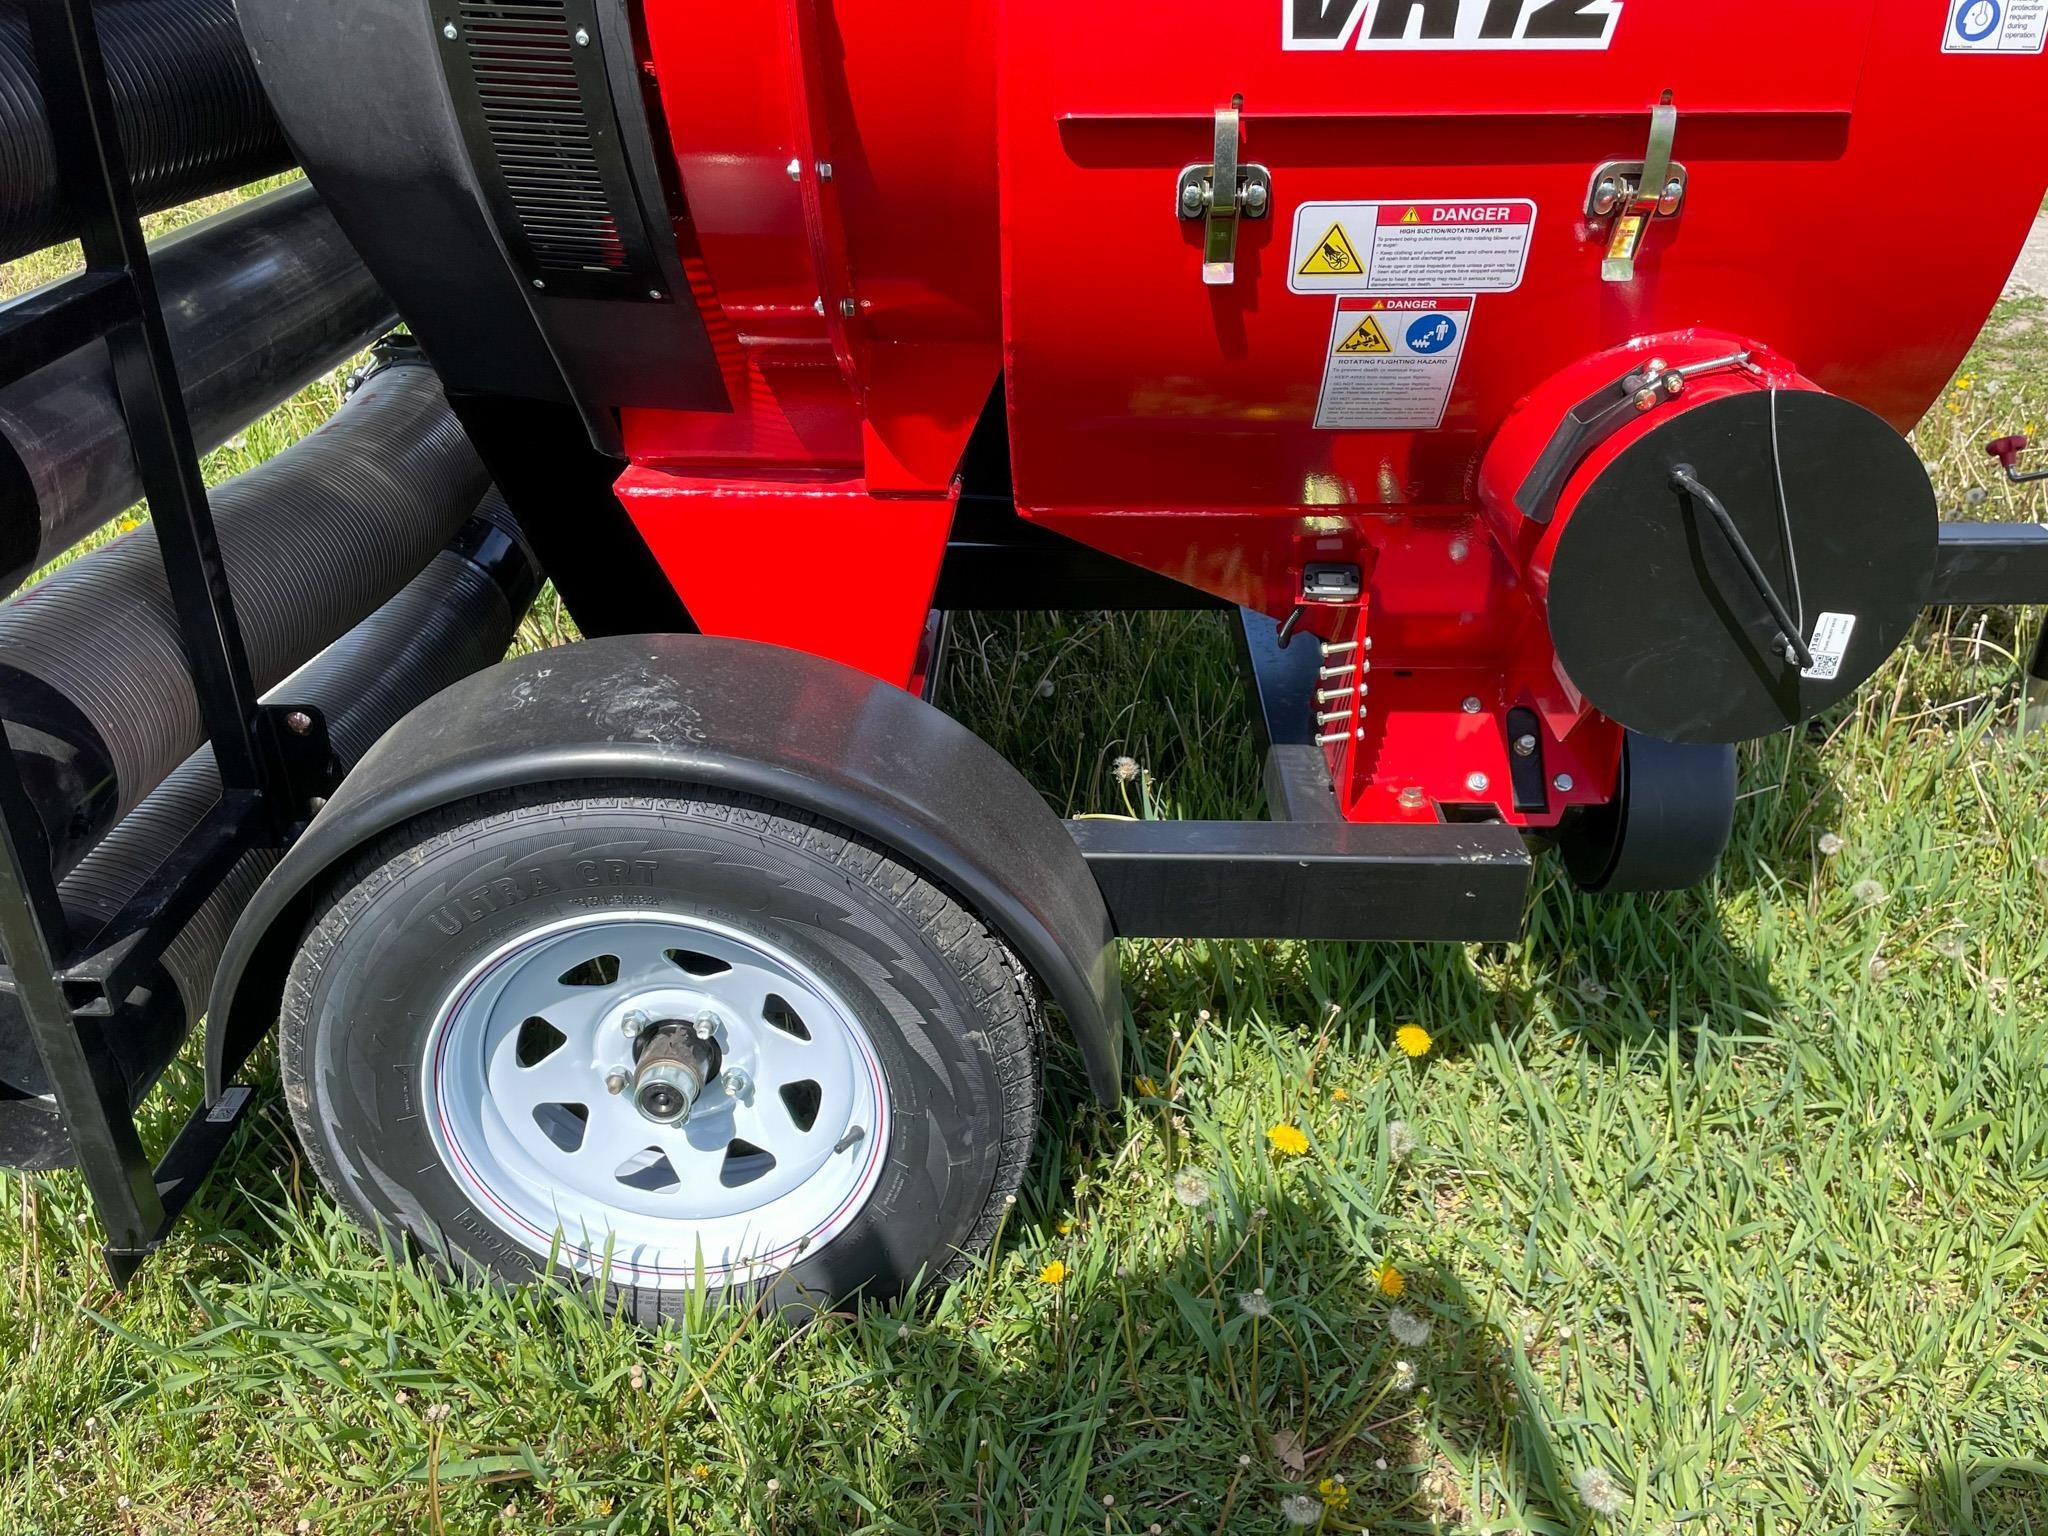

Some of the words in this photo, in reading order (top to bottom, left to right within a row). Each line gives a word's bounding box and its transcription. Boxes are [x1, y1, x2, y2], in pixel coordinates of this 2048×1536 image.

[2009, 13, 2037, 21] required
[2007, 22, 2028, 30] during
[1432, 207, 1510, 222] DANGER
[1387, 300, 1437, 309] DANGER
[428, 868, 560, 936] ULTRA
[576, 859, 659, 887] CRT
